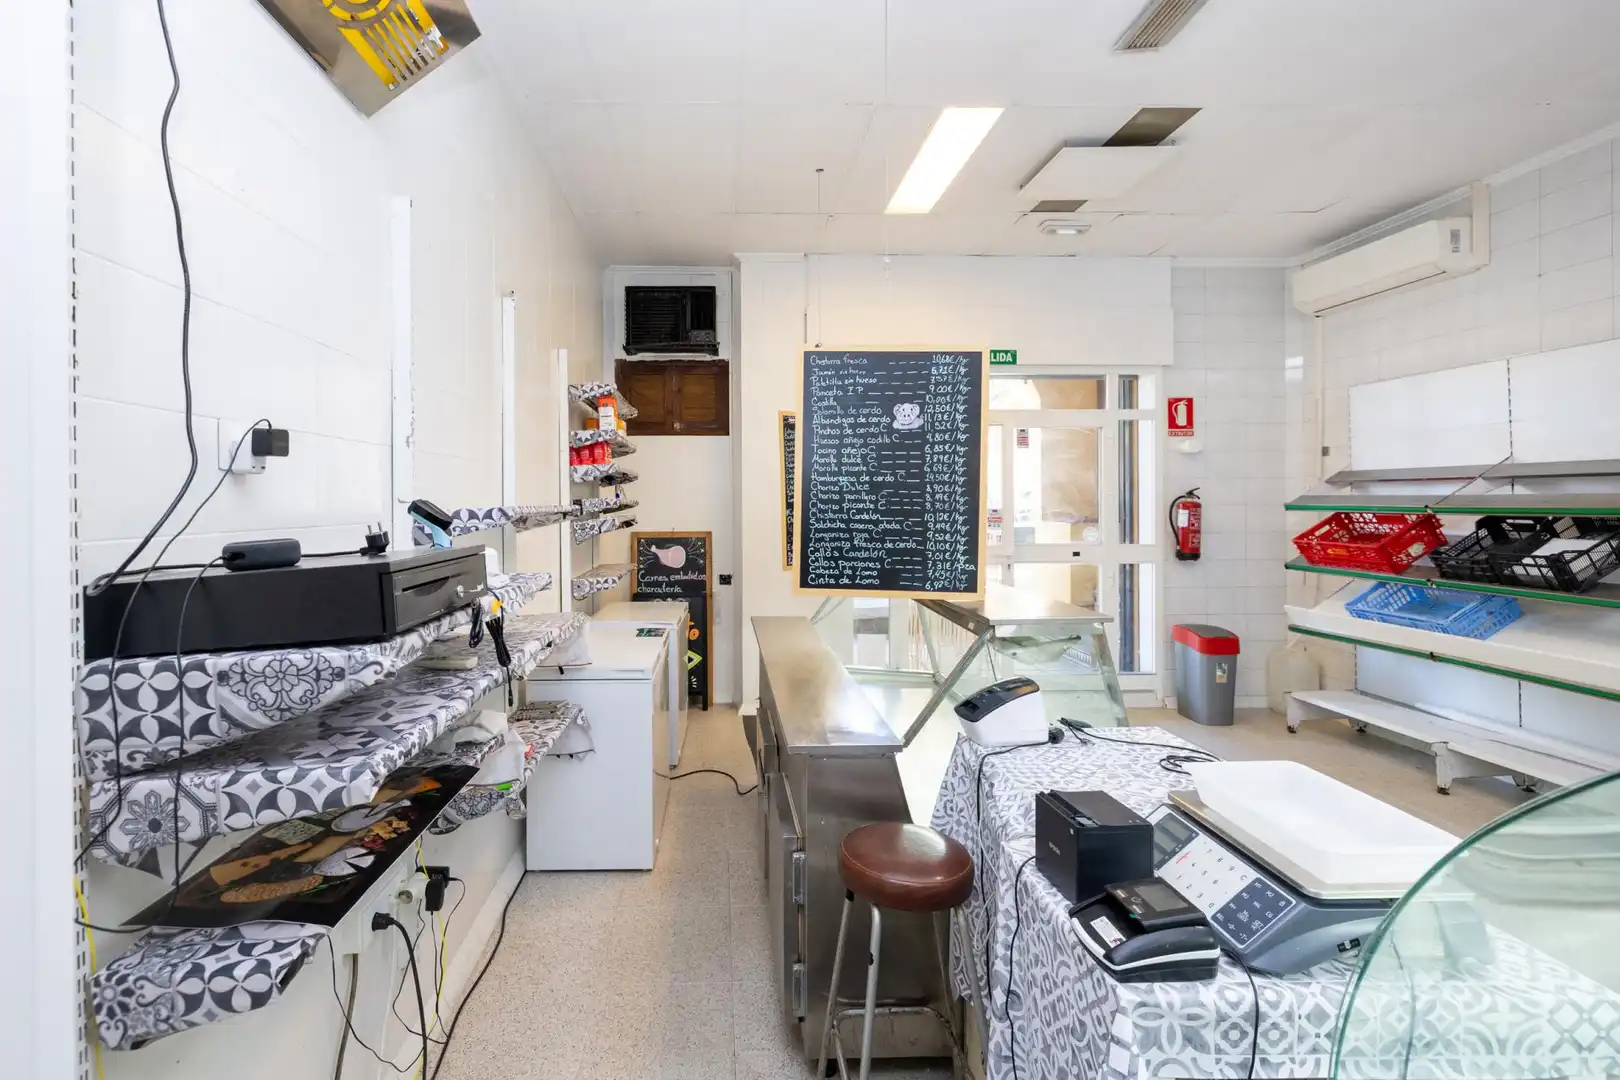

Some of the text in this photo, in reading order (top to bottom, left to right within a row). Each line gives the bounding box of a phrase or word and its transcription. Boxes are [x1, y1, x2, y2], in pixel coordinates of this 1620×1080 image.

[990, 352, 1012, 362] LIDA
[860, 472, 870, 482] de
[810, 481, 840, 490] Chorizo
[810, 490, 840, 500] Chorizo
[809, 500, 840, 510] Chorizo
[842, 500, 875, 512] picante
[808, 548, 840, 557] Callos
[808, 557, 836, 566] Callos
[844, 566, 852, 574] de
[808, 574, 836, 584] Cinta
[839, 576, 852, 584] de
